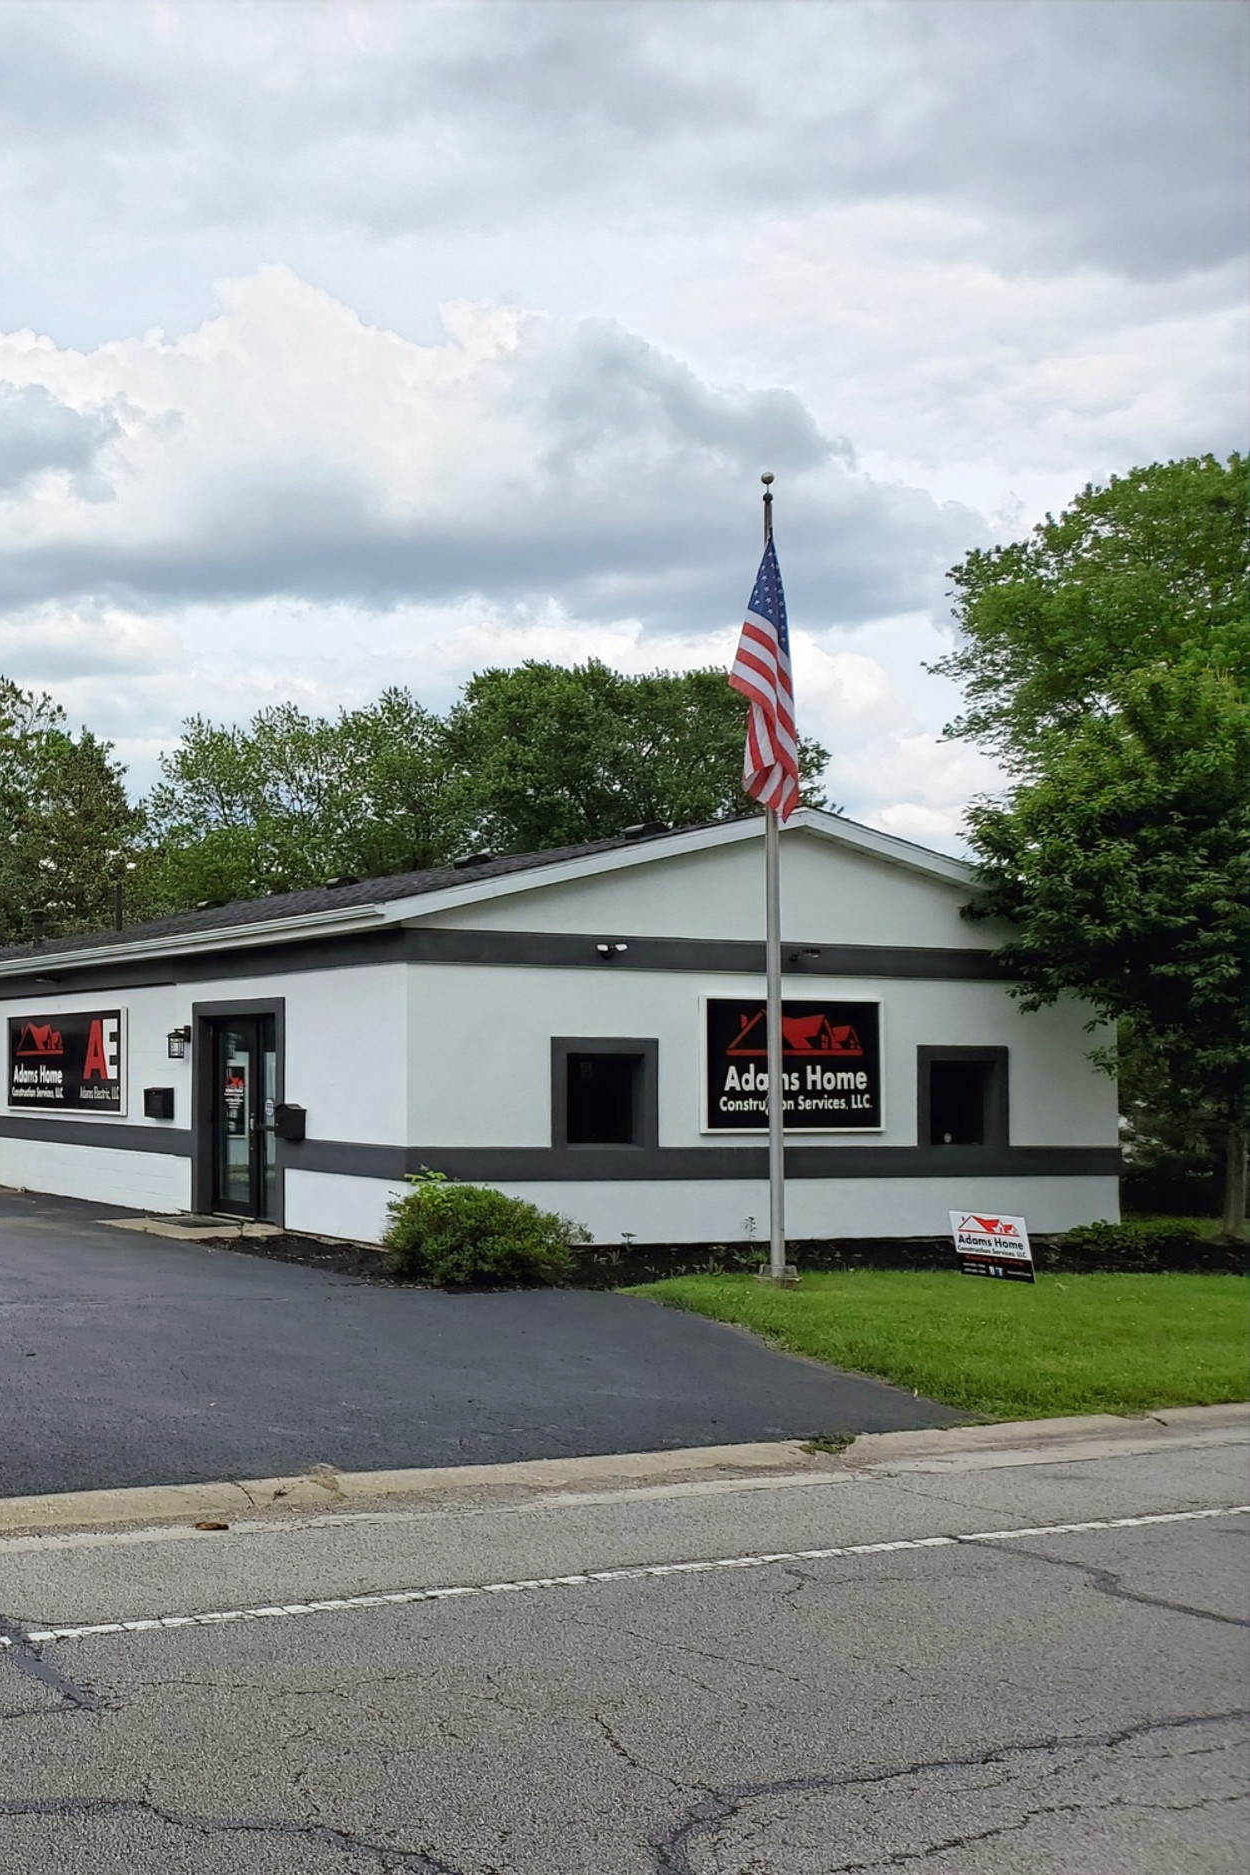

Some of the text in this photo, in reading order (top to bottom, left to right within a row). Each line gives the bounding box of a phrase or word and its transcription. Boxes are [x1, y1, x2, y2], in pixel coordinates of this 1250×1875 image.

[83, 1018, 118, 1080] AE
[13, 1063, 63, 1084] Adams Home
[806, 1065, 868, 1090] Home
[11, 1086, 36, 1097] Construction
[80, 1085, 93, 1099] Adams
[719, 1093, 873, 1111] Construon Services, LLC.
[958, 1234, 1024, 1250] Adams Home
[958, 1245, 991, 1254] Construction
